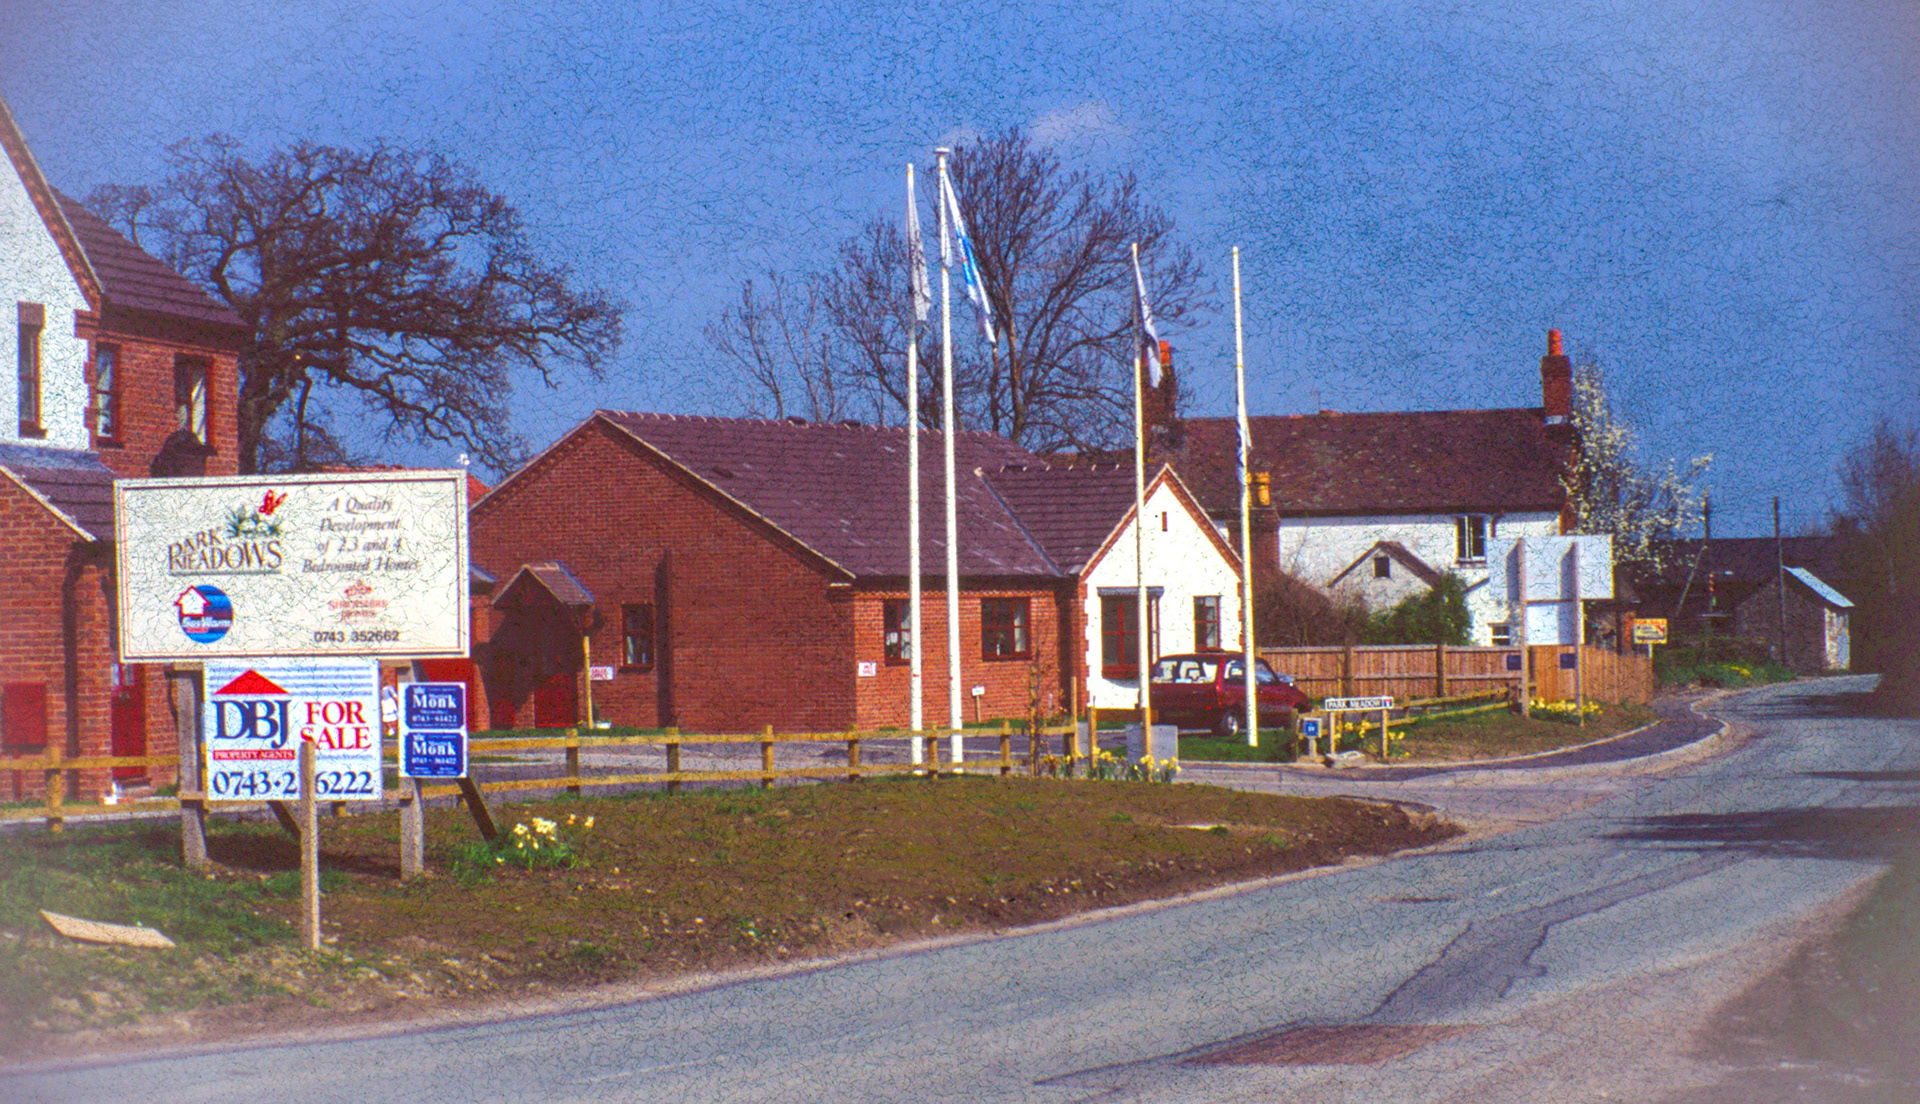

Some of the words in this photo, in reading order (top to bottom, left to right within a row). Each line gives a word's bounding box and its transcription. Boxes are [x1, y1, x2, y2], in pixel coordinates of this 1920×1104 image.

[327, 497, 339, 511] A
[345, 496, 392, 514] Quality
[320, 518, 401, 535] Development
[168, 528, 222, 560] PARK
[362, 537, 388, 551] and
[302, 558, 371, 573] Bedroomed
[376, 557, 419, 571] Homes
[314, 631, 345, 643] 0743
[351, 630, 400, 642] 352662
[413, 694, 457, 708] Monk
[1328, 700, 1347, 709] PARK
[304, 701, 366, 725] FOR
[211, 700, 292, 749] DBJ
[300, 727, 372, 750] SALE
[215, 751, 258, 761] PROPERTY
[260, 751, 295, 760] AGENTS
[413, 741, 457, 755] Monk
